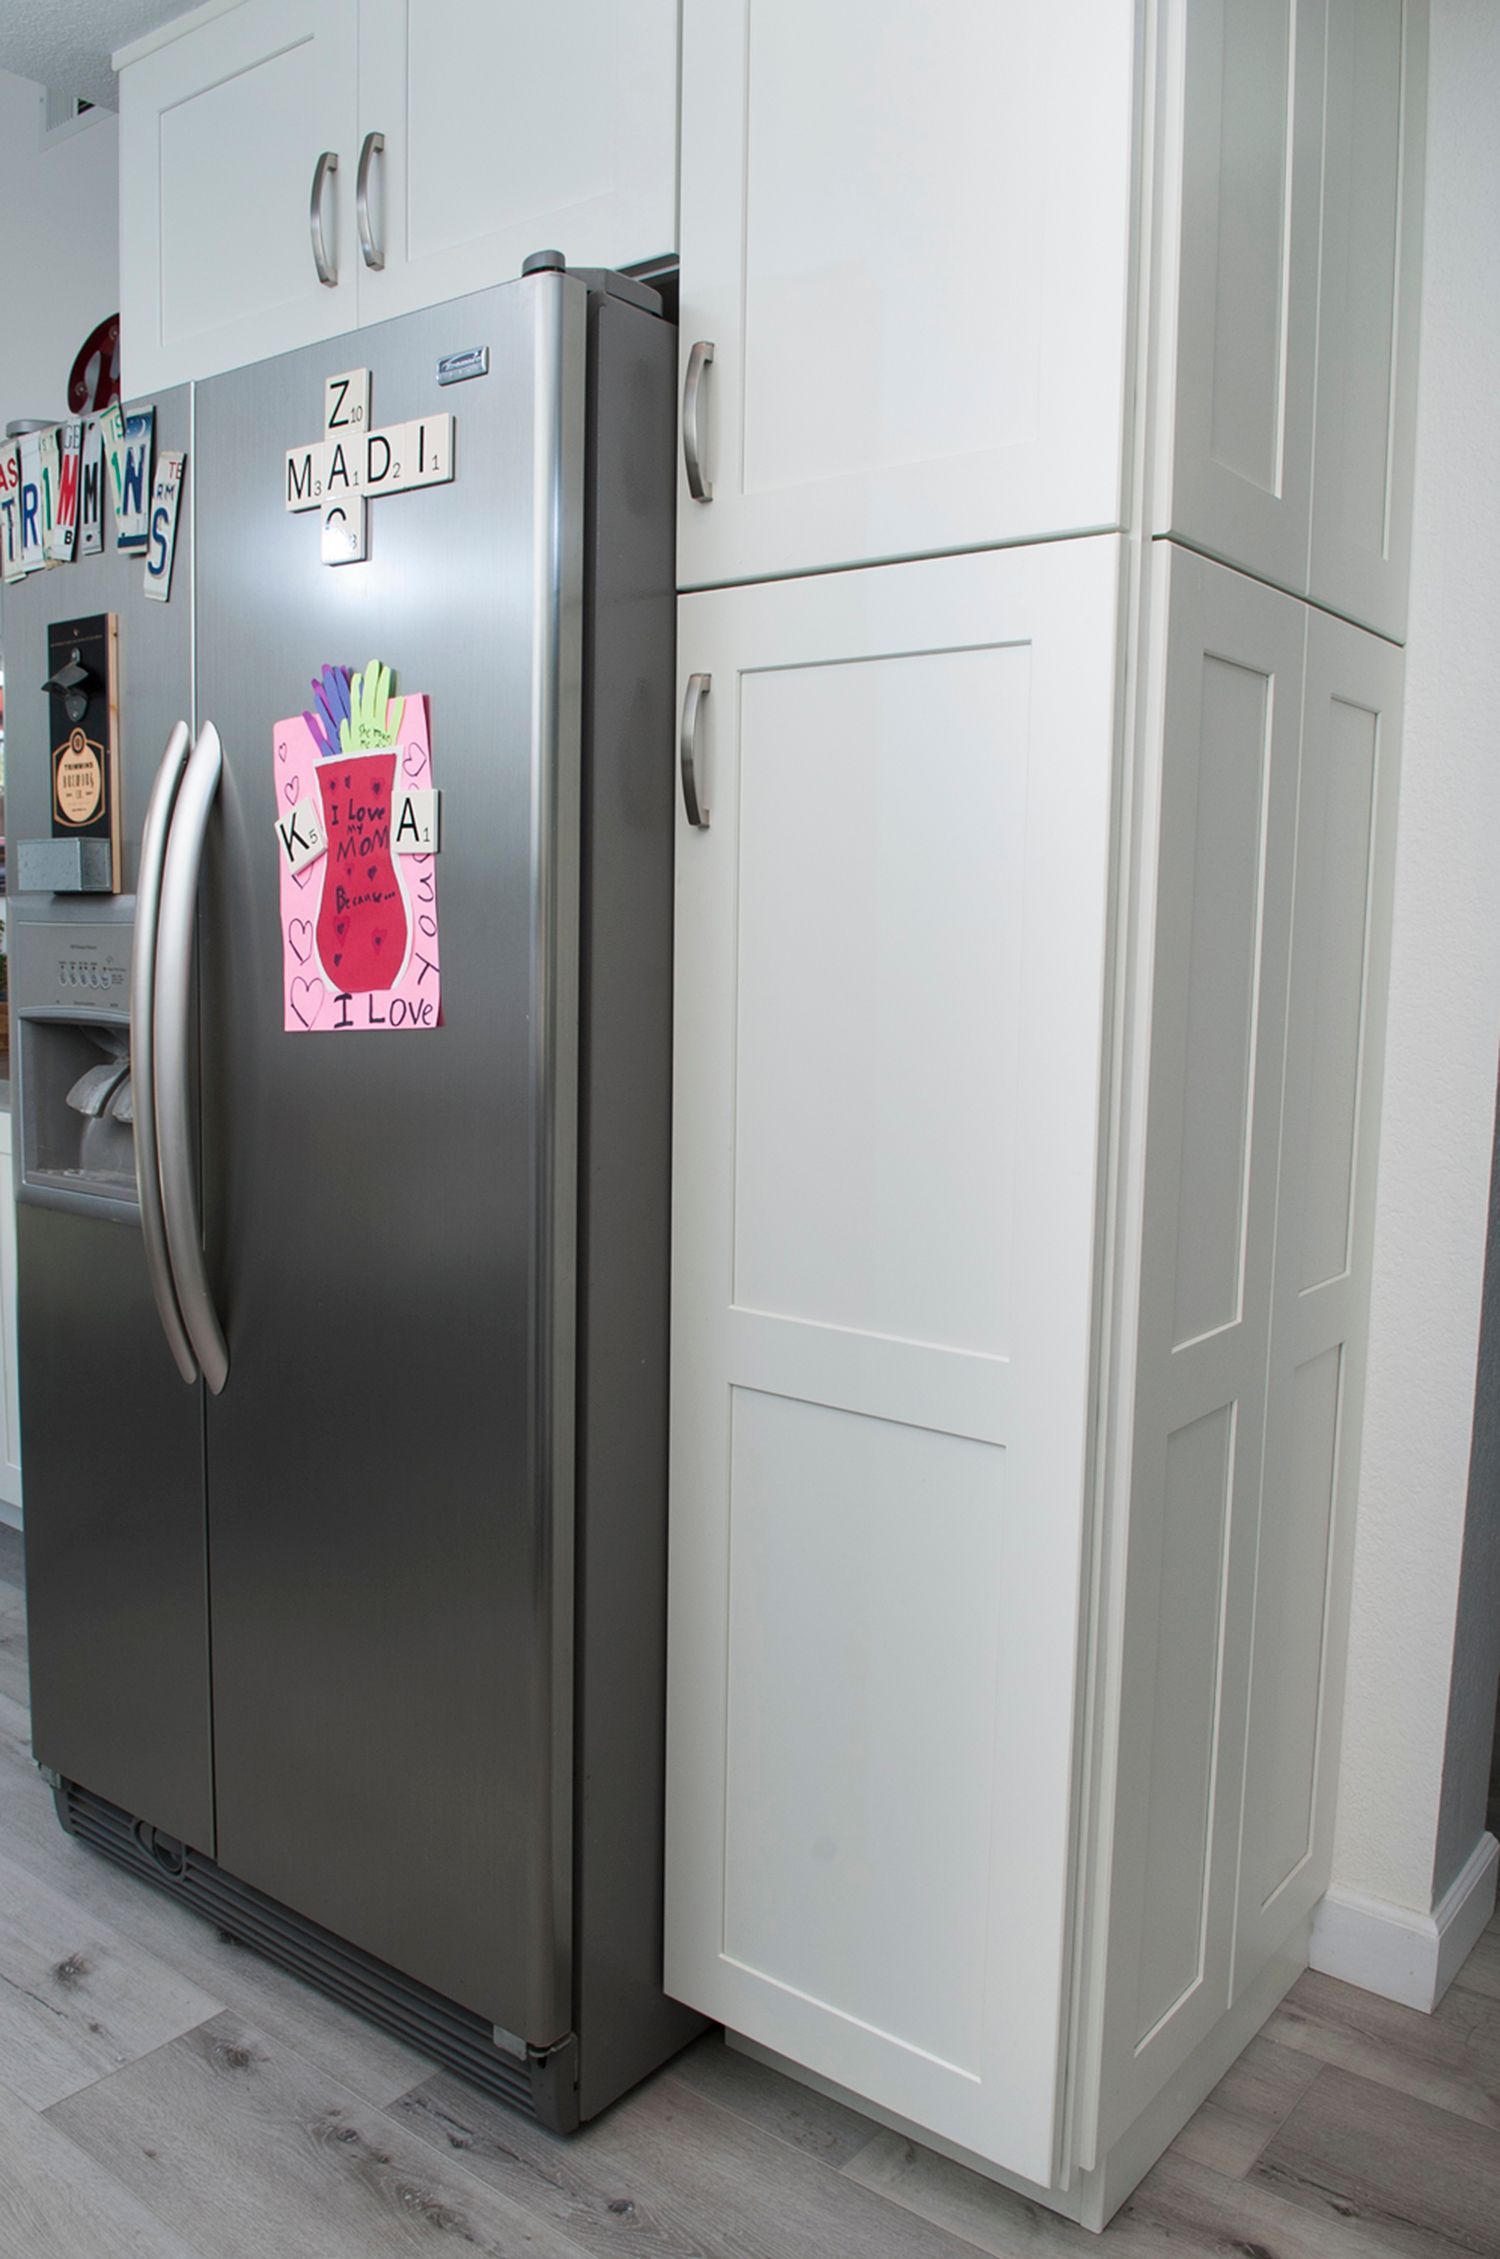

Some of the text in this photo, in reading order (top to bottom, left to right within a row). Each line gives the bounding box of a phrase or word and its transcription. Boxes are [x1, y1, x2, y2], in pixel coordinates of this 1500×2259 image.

[329, 379, 350, 429] Z
[279, 812, 310, 862] K
[332, 804, 339, 826] I
[396, 797, 420, 843] A
[333, 993, 354, 1029] I
